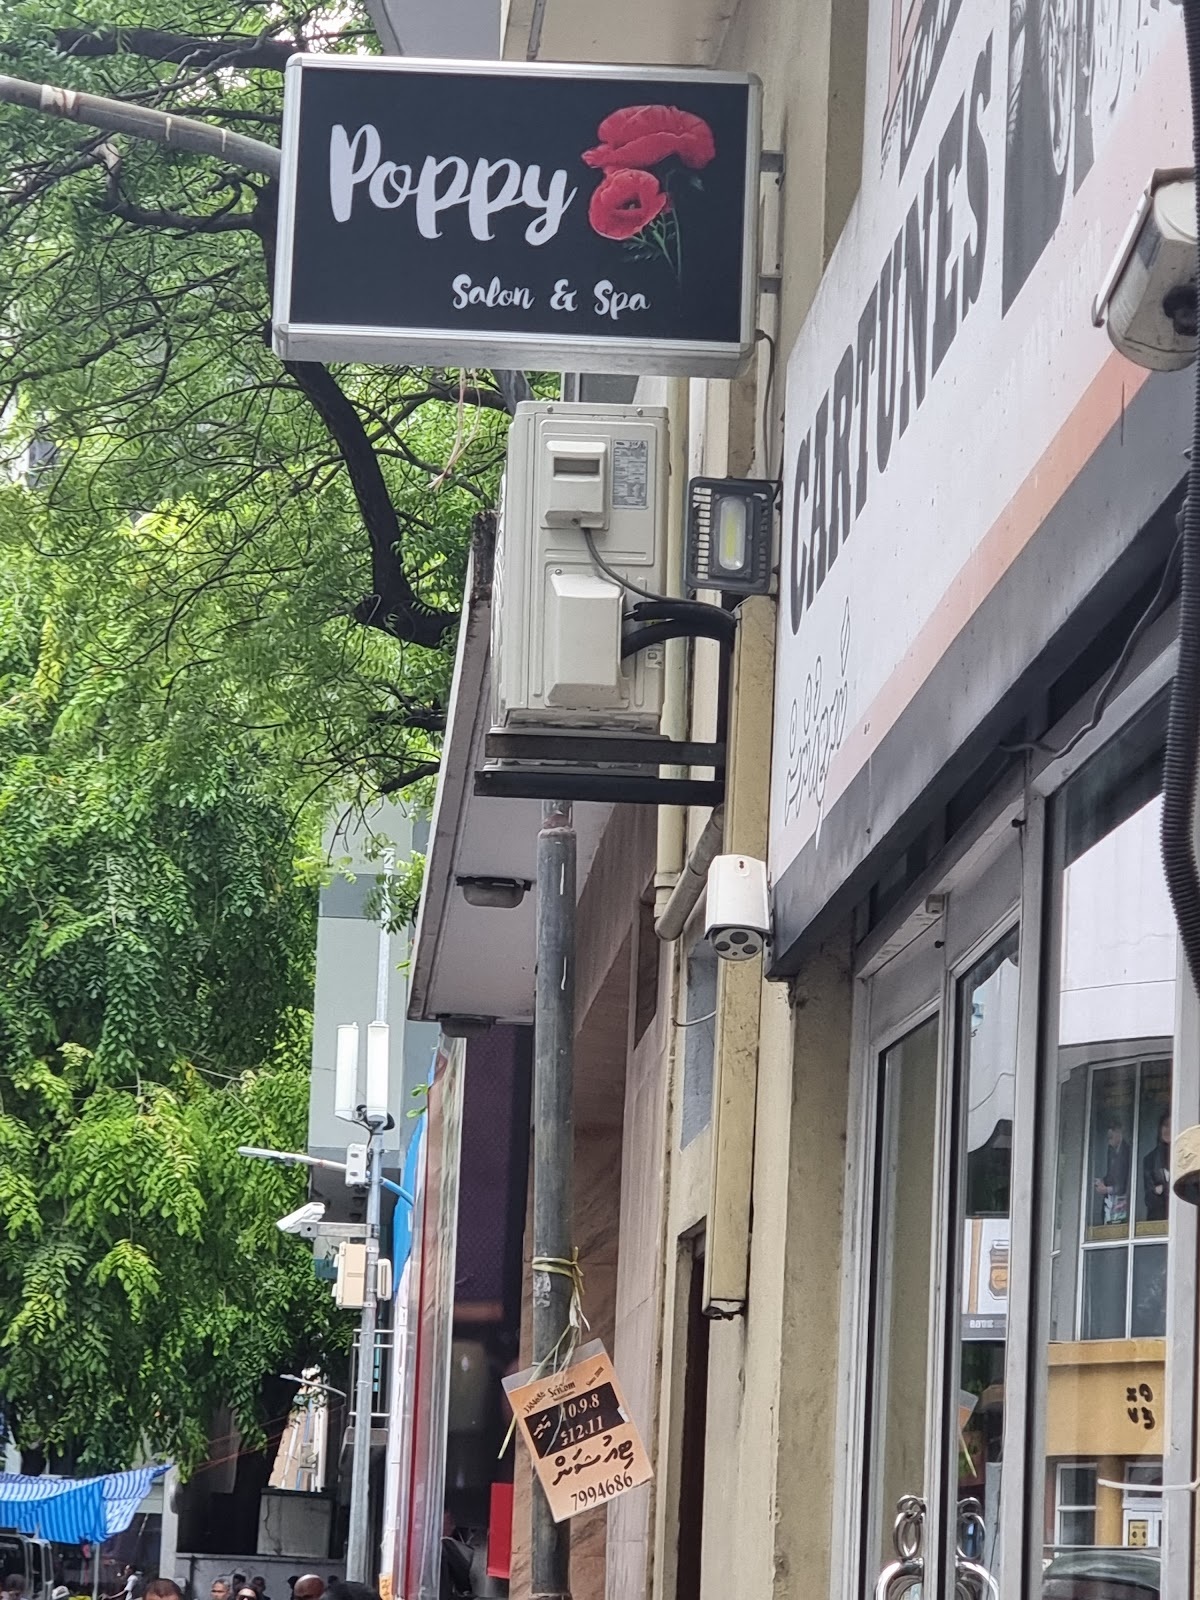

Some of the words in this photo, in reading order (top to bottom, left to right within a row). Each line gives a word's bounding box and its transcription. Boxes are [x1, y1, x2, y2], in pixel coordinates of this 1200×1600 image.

[329, 123, 578, 246] Poppy
[451, 273, 535, 310] Salon
[550, 278, 578, 312] &
[593, 278, 651, 320] Spa
[790, 28, 994, 635] CARTUNES
[570, 1471, 633, 1511] 7994686
